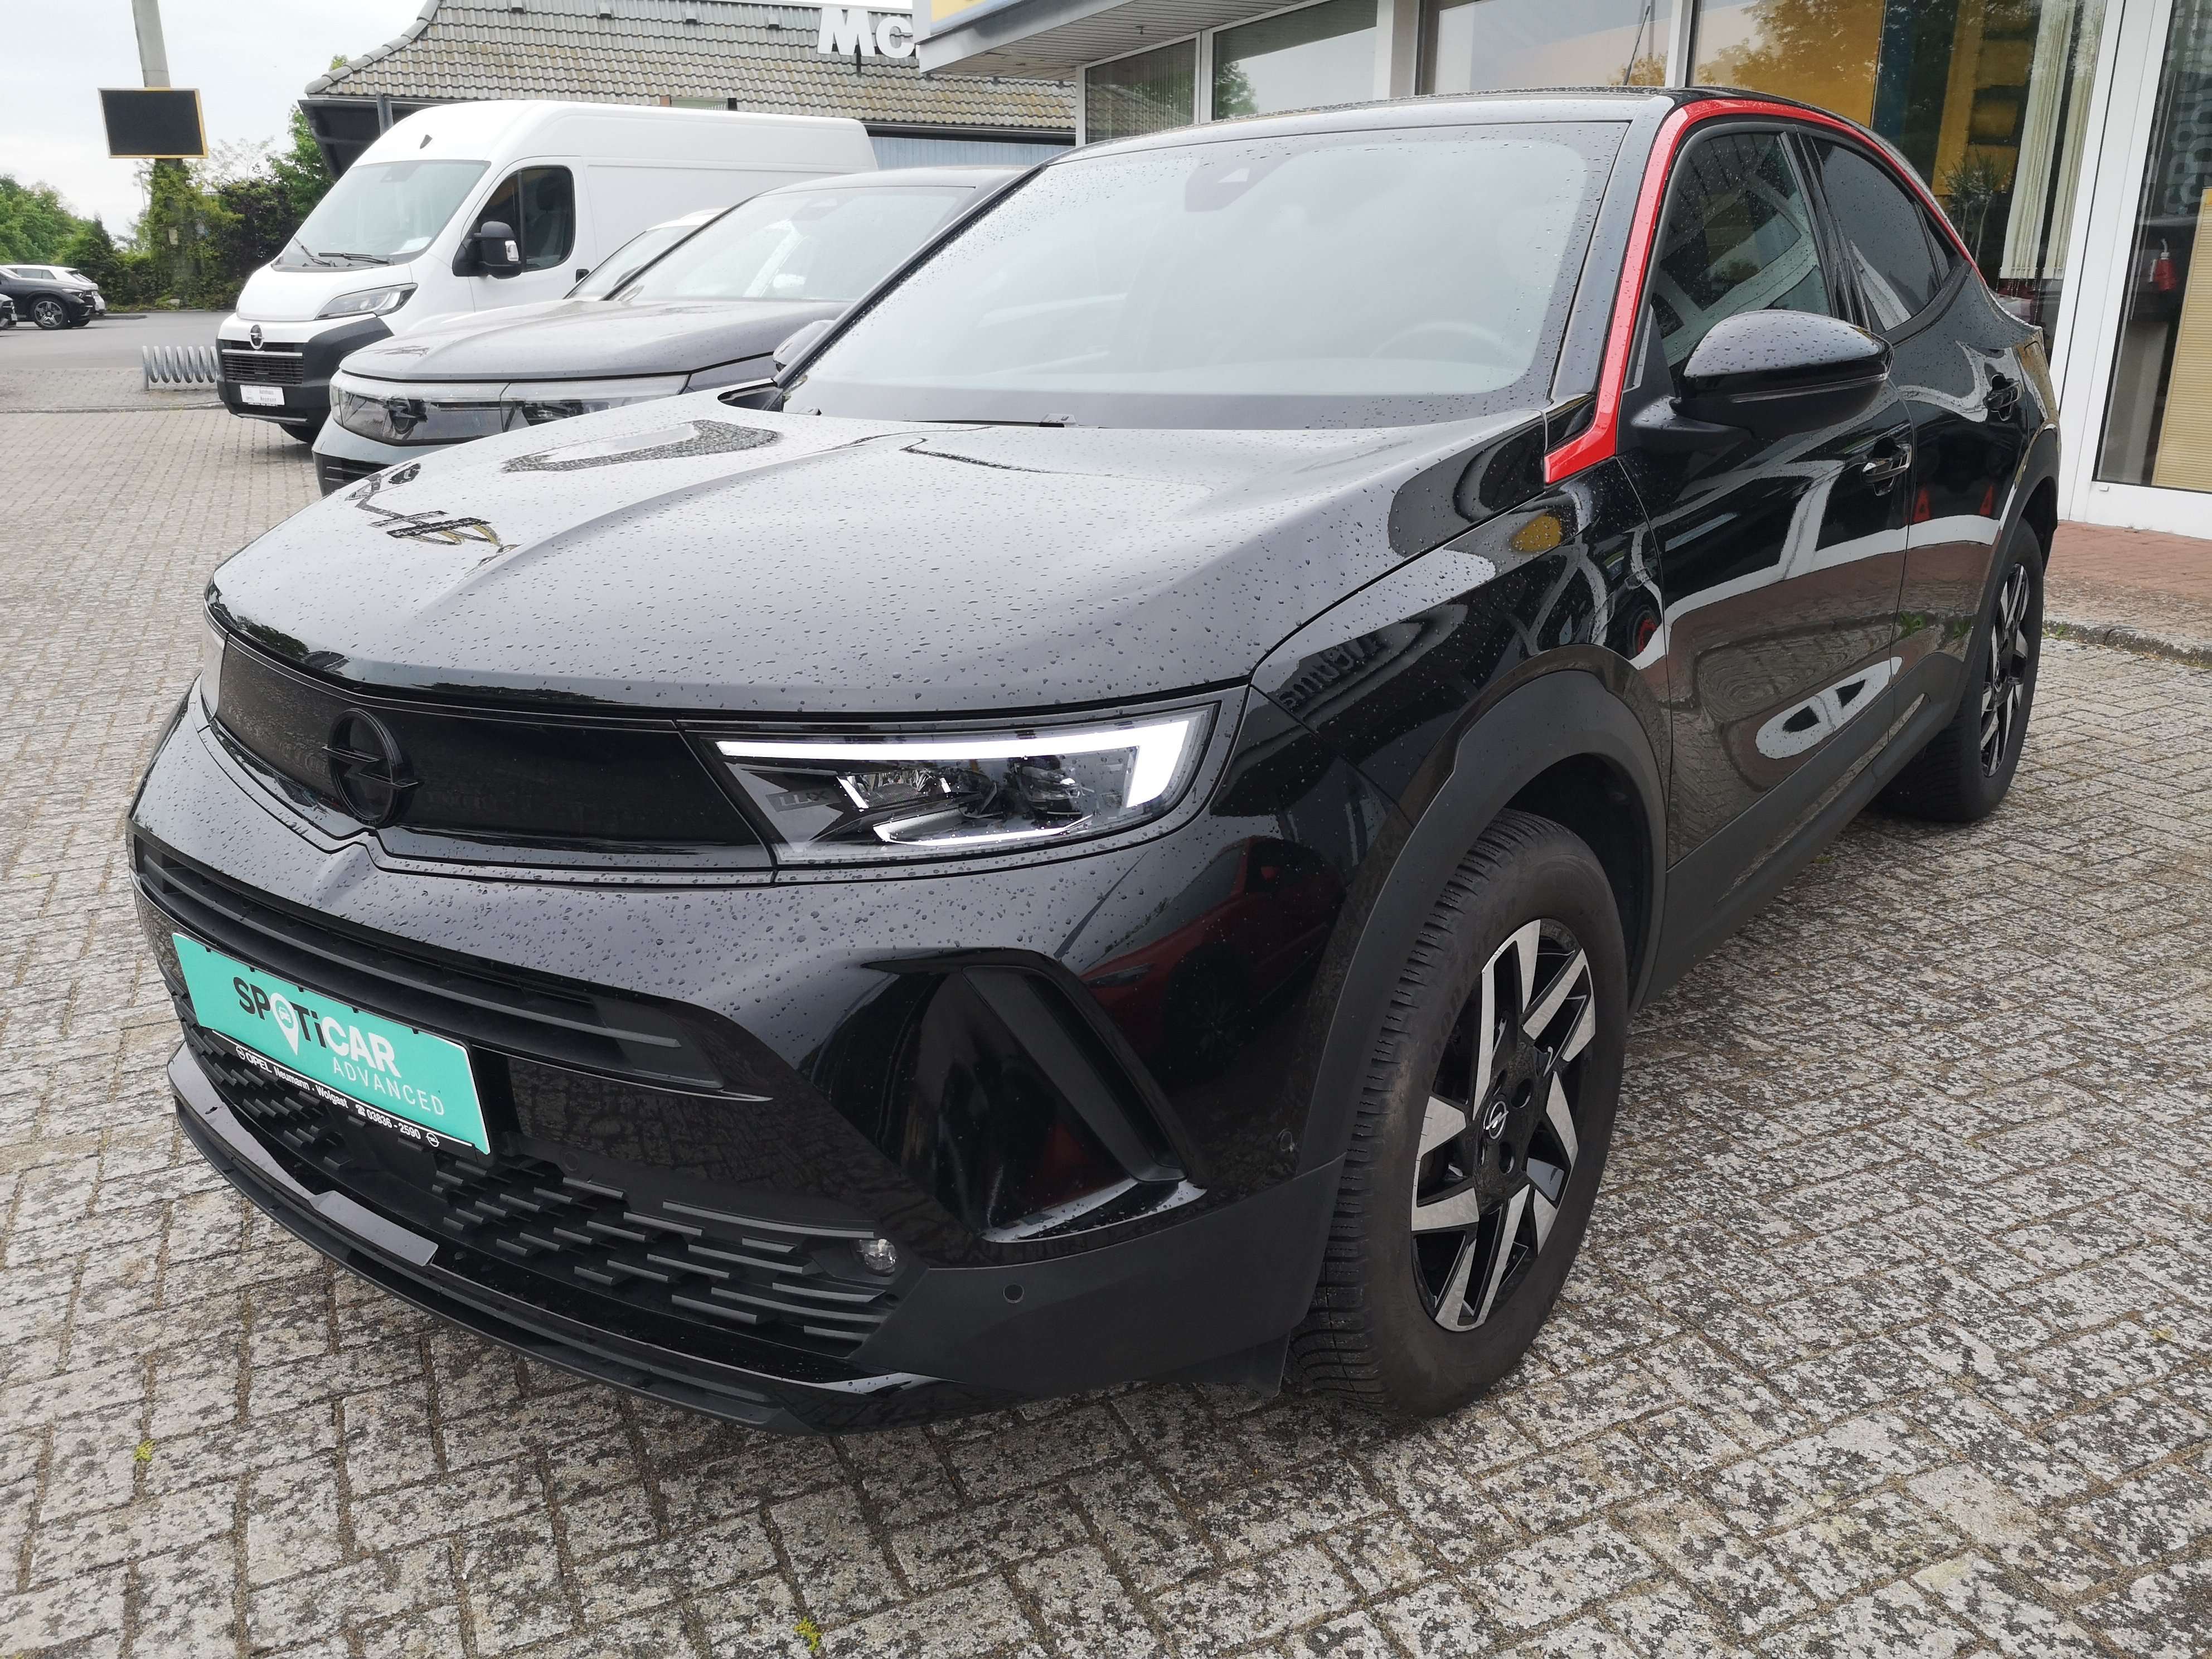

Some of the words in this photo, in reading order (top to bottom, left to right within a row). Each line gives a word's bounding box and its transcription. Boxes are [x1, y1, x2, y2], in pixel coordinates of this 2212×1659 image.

[817, 7, 919, 59] Mc
[245, 1052, 273, 1073] OPEL
[273, 1066, 311, 1091] Neumann
[315, 1084, 349, 1109] Wolgast
[366, 1108, 393, 1128] 03836
[398, 1122, 421, 1140] 2590
[333, 1056, 445, 1115] ADVANCED
